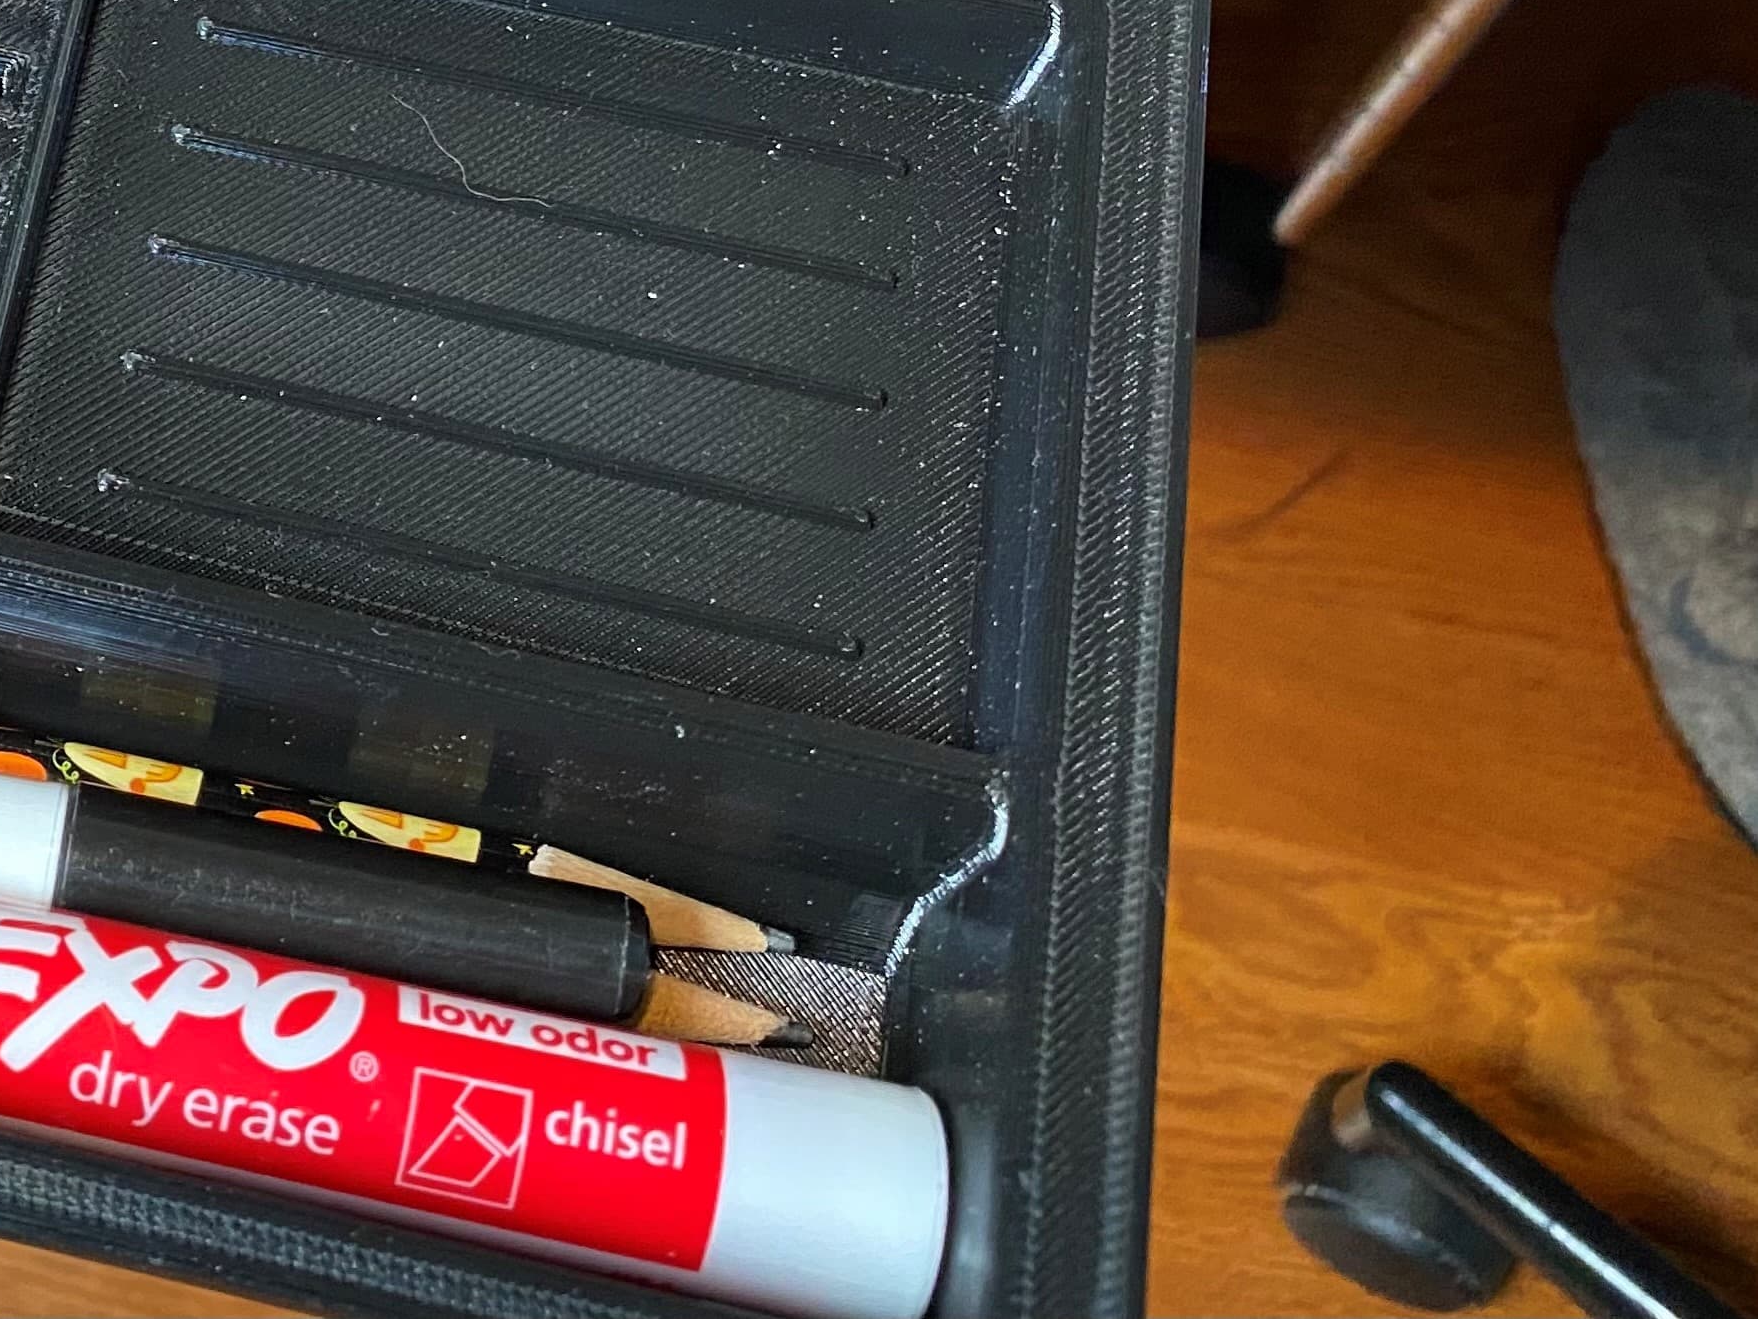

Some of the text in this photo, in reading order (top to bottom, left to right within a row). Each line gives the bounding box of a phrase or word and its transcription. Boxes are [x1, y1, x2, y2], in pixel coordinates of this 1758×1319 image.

[418, 993, 659, 1070] low odor
[70, 1050, 342, 1156] dry erase
[545, 1100, 688, 1170] chisel
